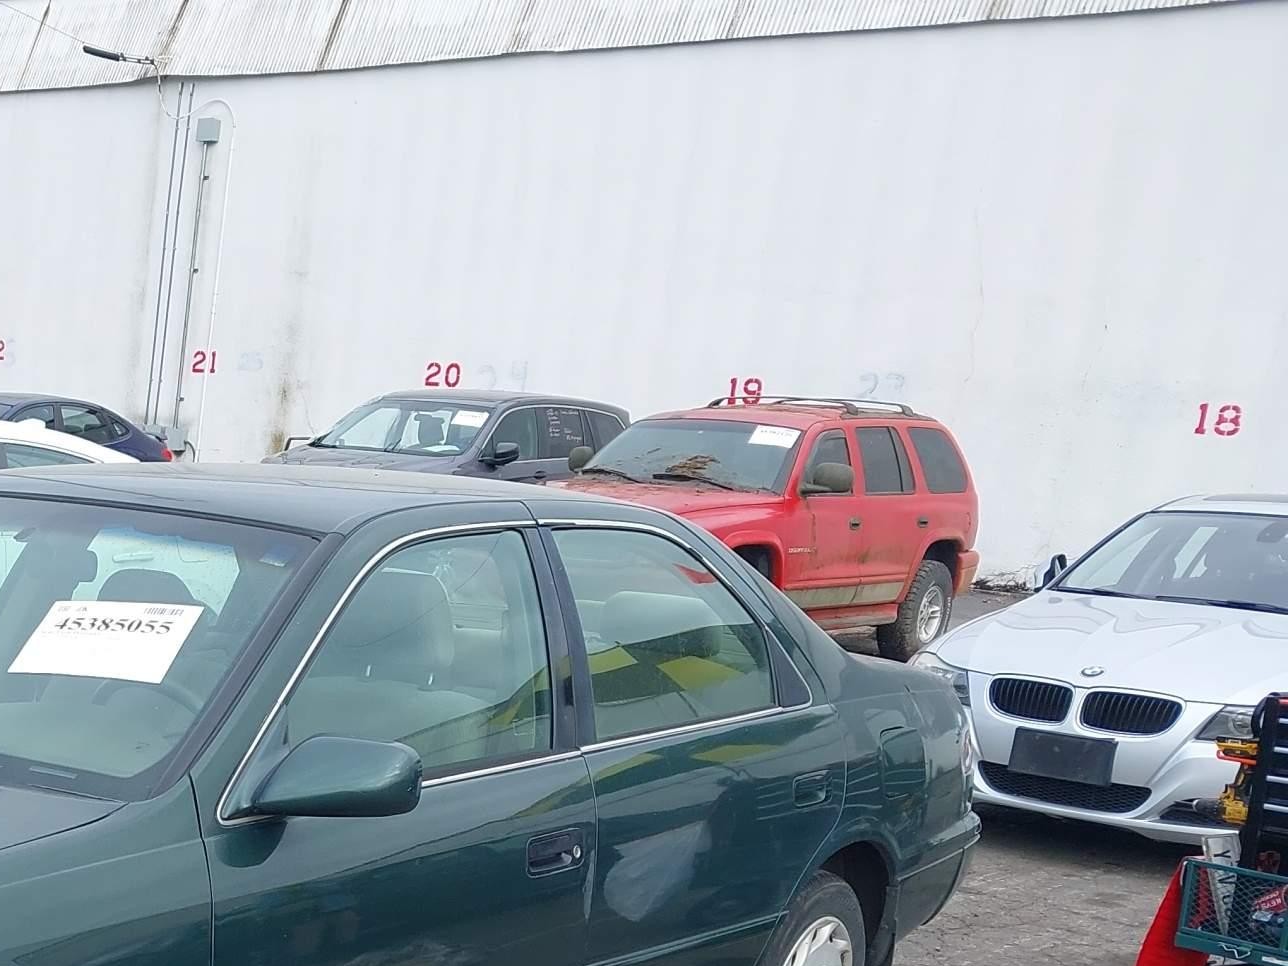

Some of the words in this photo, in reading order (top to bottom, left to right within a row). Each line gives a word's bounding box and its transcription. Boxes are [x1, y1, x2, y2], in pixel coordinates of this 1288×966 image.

[192, 351, 216, 374] 21
[425, 363, 459, 387] 20
[727, 377, 764, 405] 19
[1194, 403, 1242, 437] 18
[54, 616, 174, 634] 45385055
